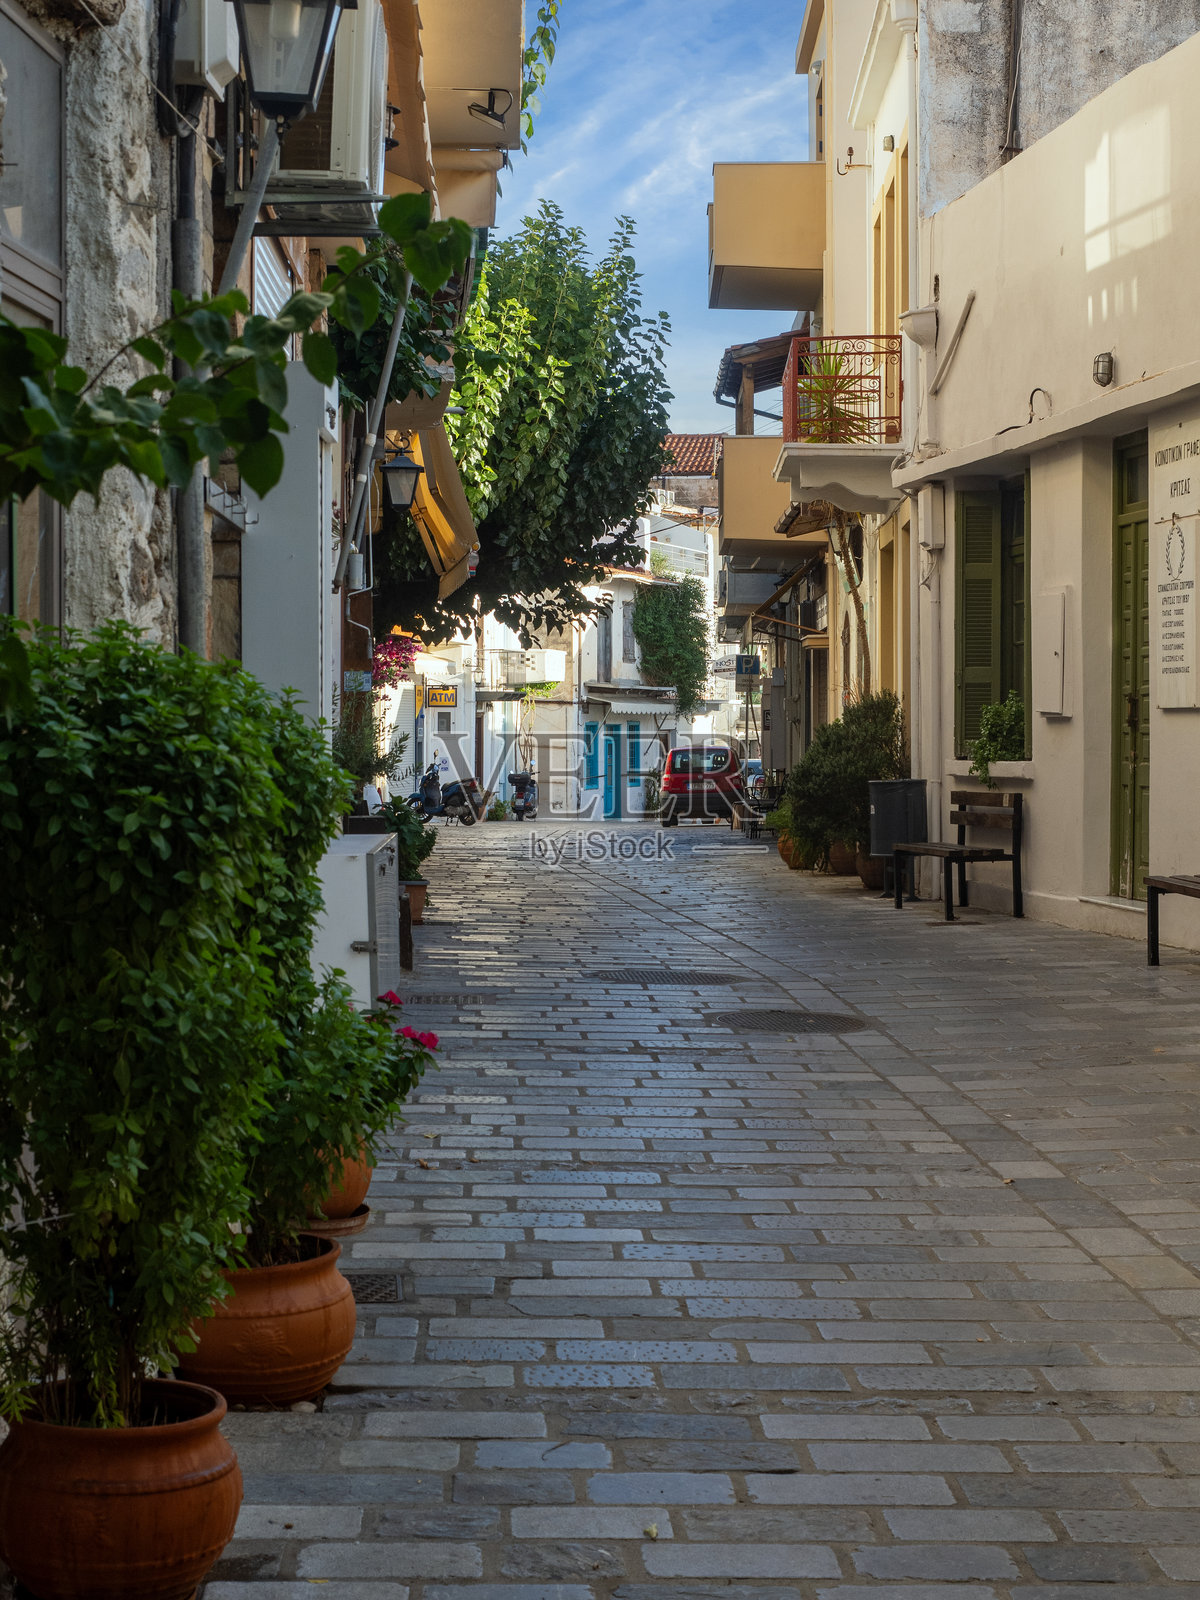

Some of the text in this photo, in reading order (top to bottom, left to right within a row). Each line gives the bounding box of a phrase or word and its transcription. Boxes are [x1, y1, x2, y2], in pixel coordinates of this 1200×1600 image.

[1170, 478, 1191, 498] ΚΡΙΤΣΑΣ
[742, 657, 754, 673] P
[430, 692, 455, 703] ATM
